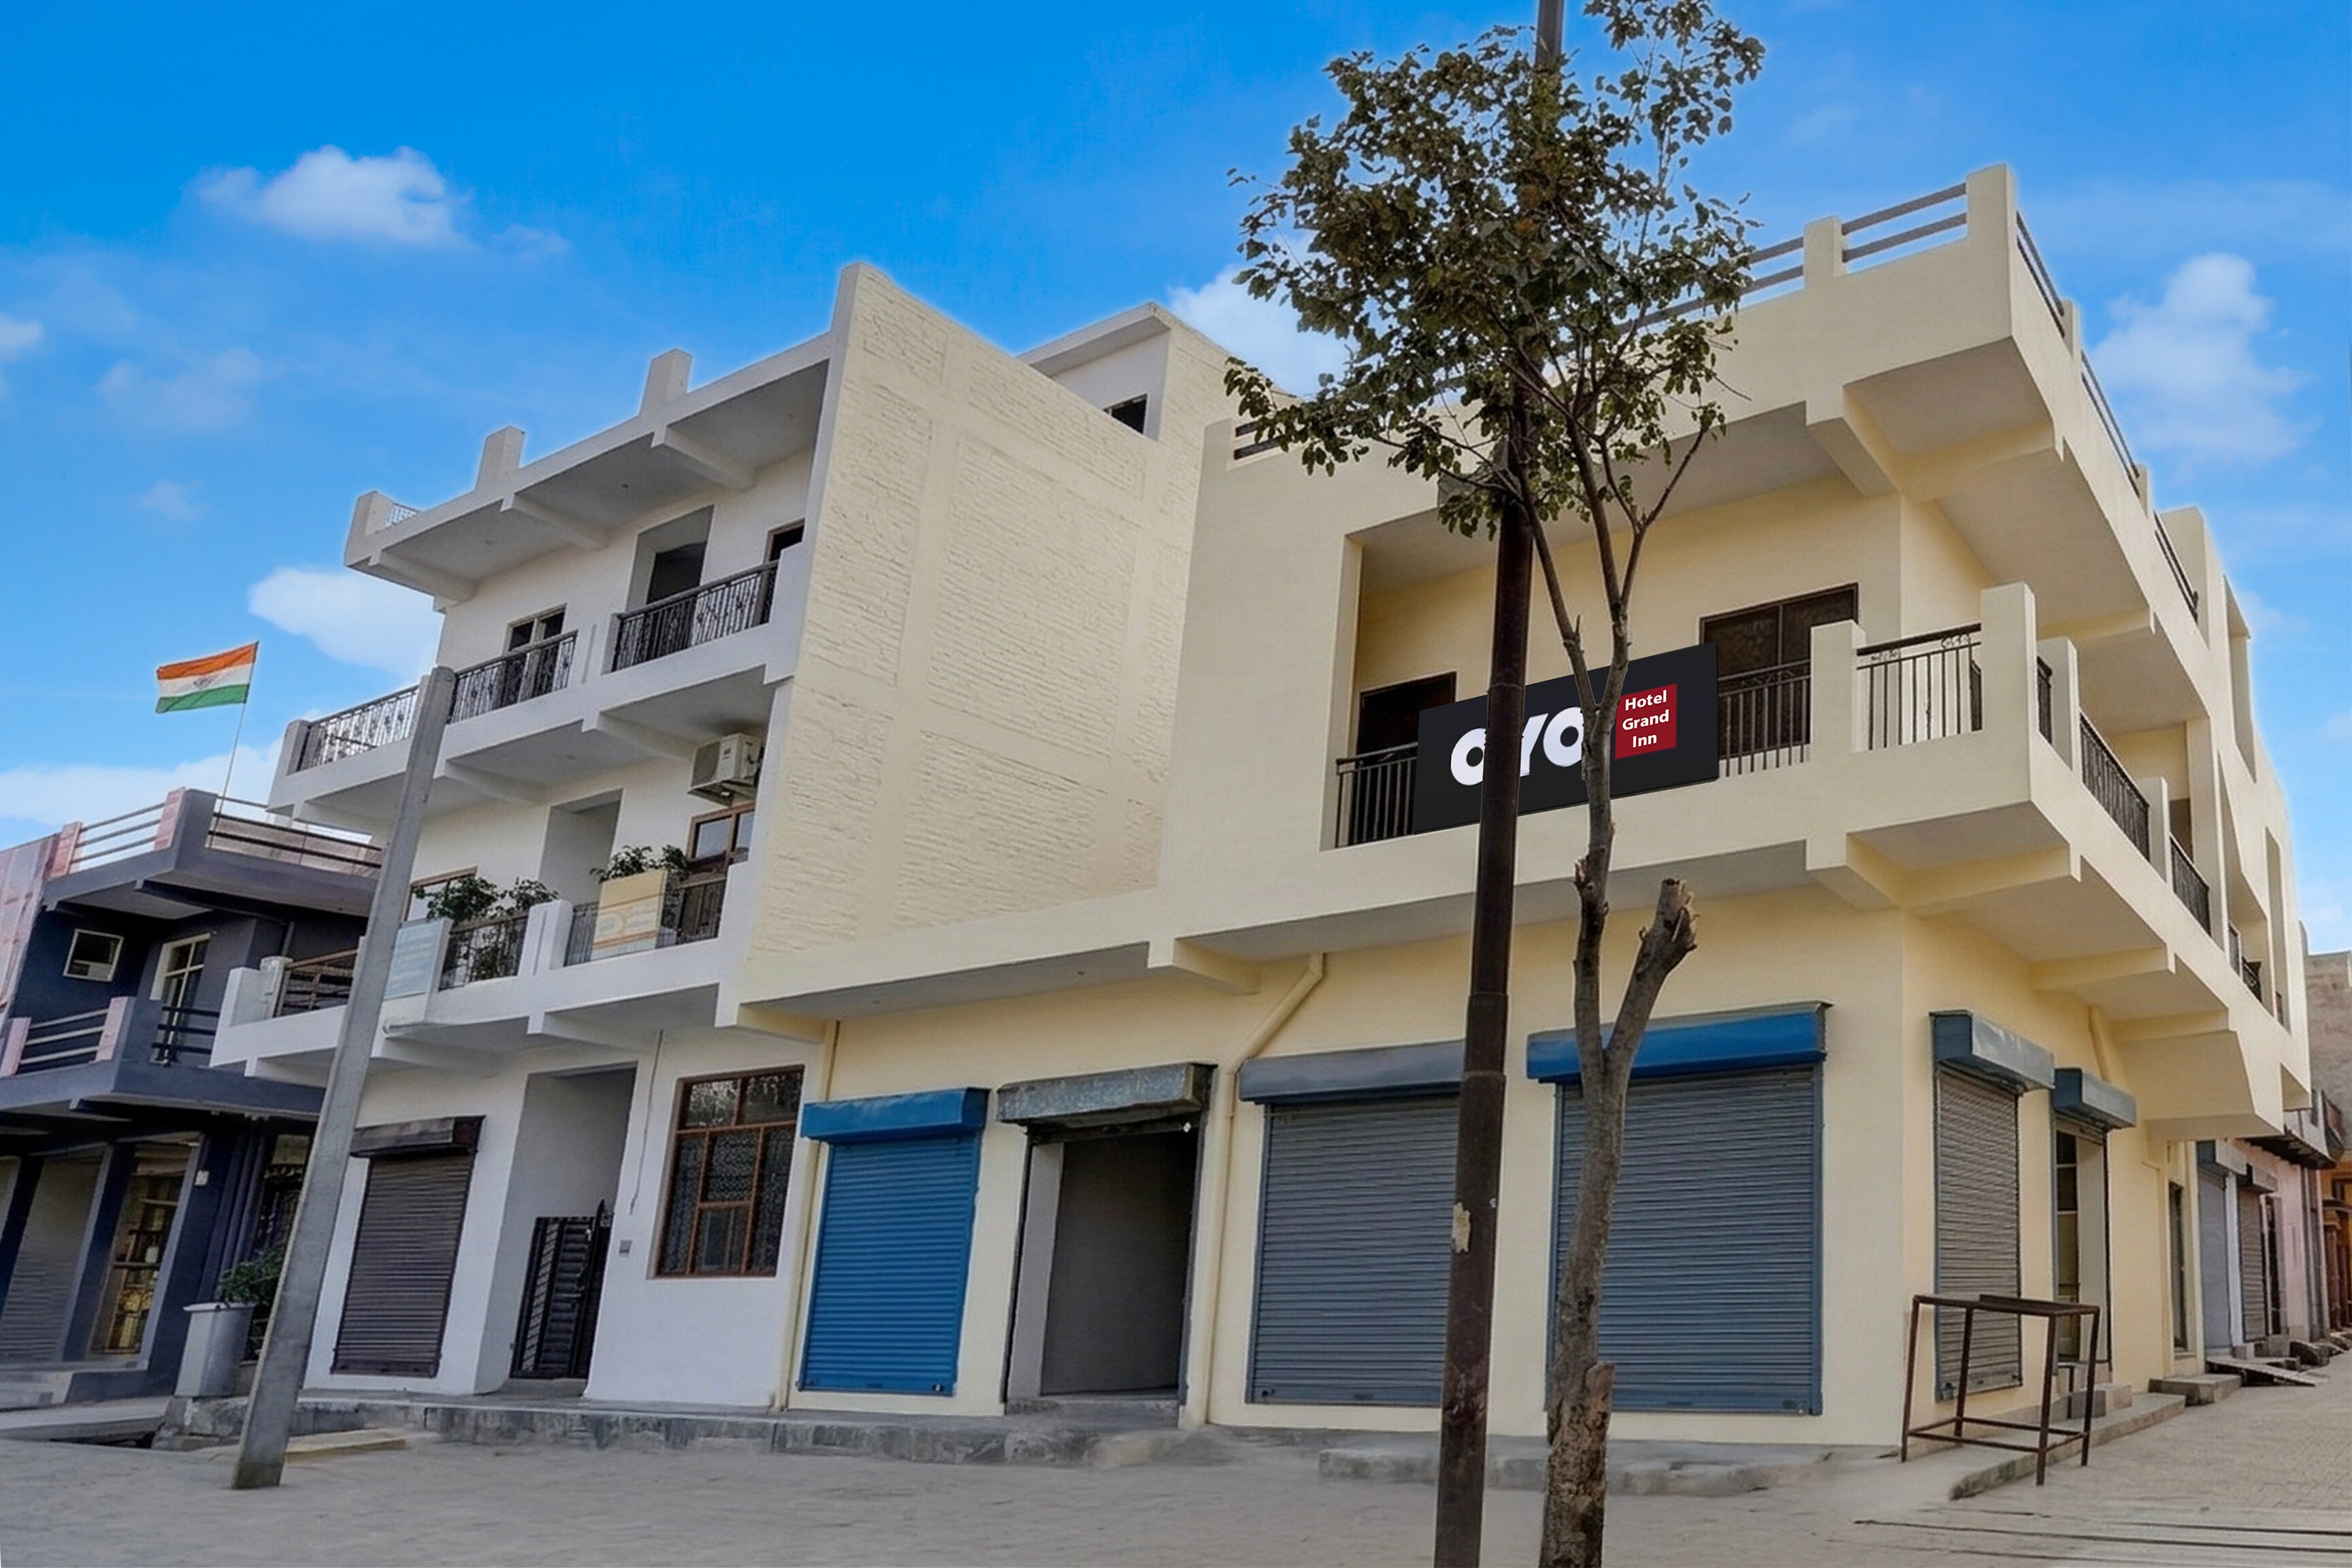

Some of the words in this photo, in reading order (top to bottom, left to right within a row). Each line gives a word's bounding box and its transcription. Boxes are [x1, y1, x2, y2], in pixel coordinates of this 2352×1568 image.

[1624, 689, 1667, 711] Hotel
[1622, 709, 1669, 731] Grand
[1632, 734, 1658, 748] Inn
